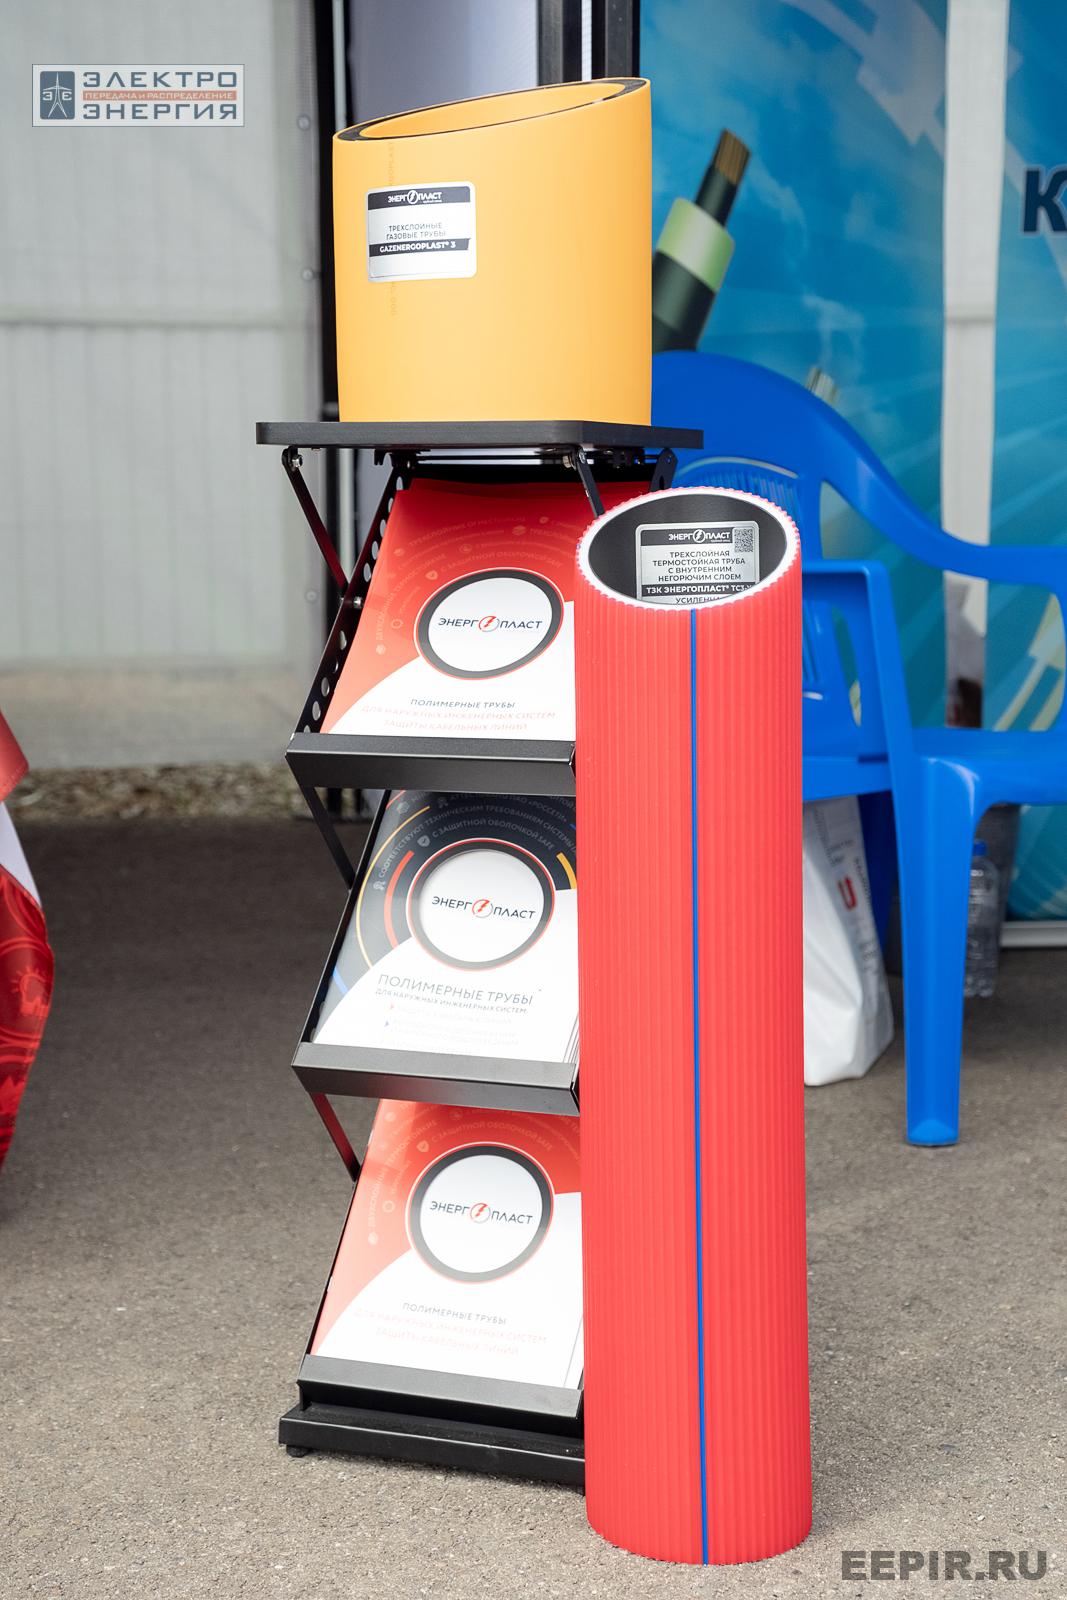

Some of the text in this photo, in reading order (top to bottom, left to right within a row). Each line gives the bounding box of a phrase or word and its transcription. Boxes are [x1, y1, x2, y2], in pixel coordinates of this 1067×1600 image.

[388, 222, 443, 232] ТРЕХСЛОЙНЫЕ
[386, 230, 446, 241] ГАЗОВЫЕ ТРУБЫ
[450, 241, 457, 249] 3
[669, 550, 730, 558] ТРЕХСЛОЙНАЯ
[652, 557, 746, 567] ТЕРМОСТОЙКАЯ ТРУБА
[675, 566, 733, 574] ВНУТРЕННИМ
[410, 699, 481, 709] ПОЛИМЕРНЫЕ
[486, 805, 544, 826] ТРЕБОВАНИЯМ
[432, 830, 439, 838] С
[438, 818, 486, 836] ЗАЩИТНОЙ
[487, 818, 539, 840] ОБОЛОЧКОЙ
[378, 974, 533, 1006] ПОЛИМЕРНЫЕ ТРУБЫ
[375, 988, 392, 996] ДЛЯ
[393, 990, 439, 1005] НАРУЖНЫХ
[439, 999, 494, 1012] ИНЖЕНЕРНЫХ
[402, 1302, 507, 1325] ПОЛИМЕРНЫЕ ТРУБЫ
